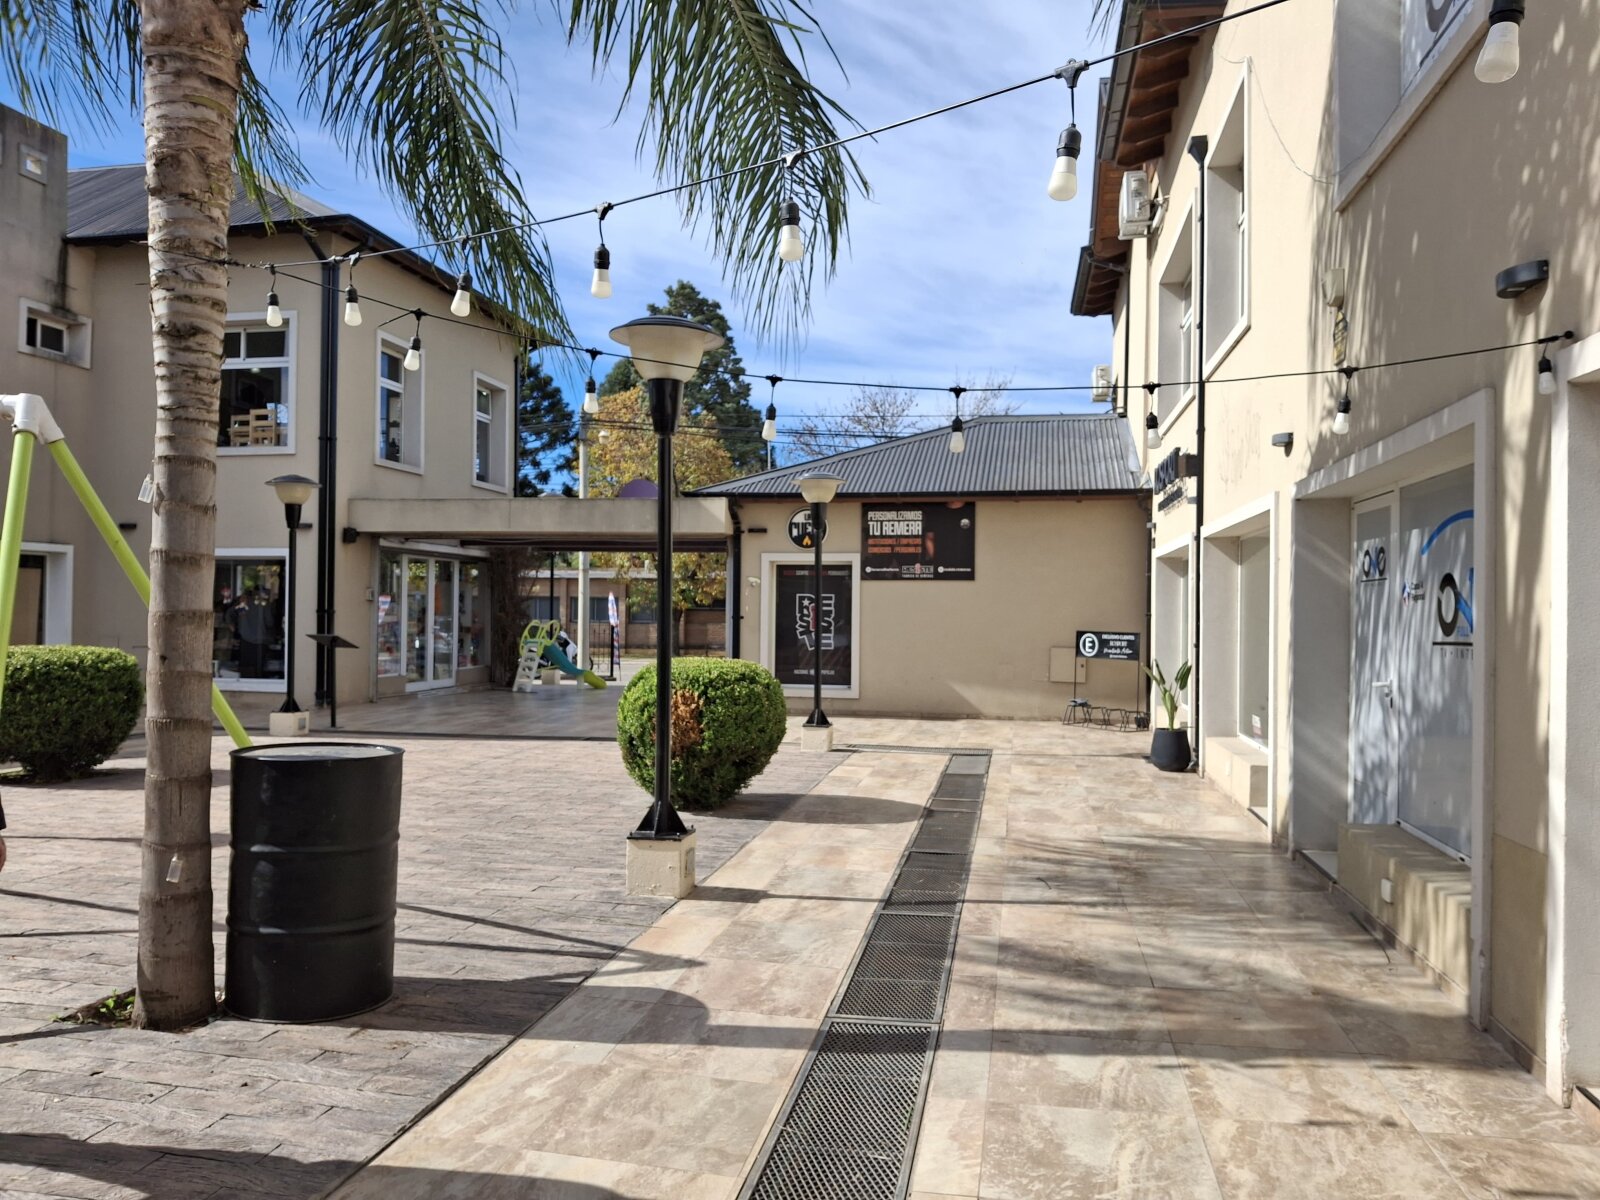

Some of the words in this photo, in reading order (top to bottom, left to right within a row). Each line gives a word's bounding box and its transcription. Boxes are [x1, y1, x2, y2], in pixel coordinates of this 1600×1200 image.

[868, 511, 922, 520] PERSONALIZAMOS
[868, 521, 880, 536] TU
[882, 521, 922, 536] REMERA
[1085, 637, 1093, 652] E
